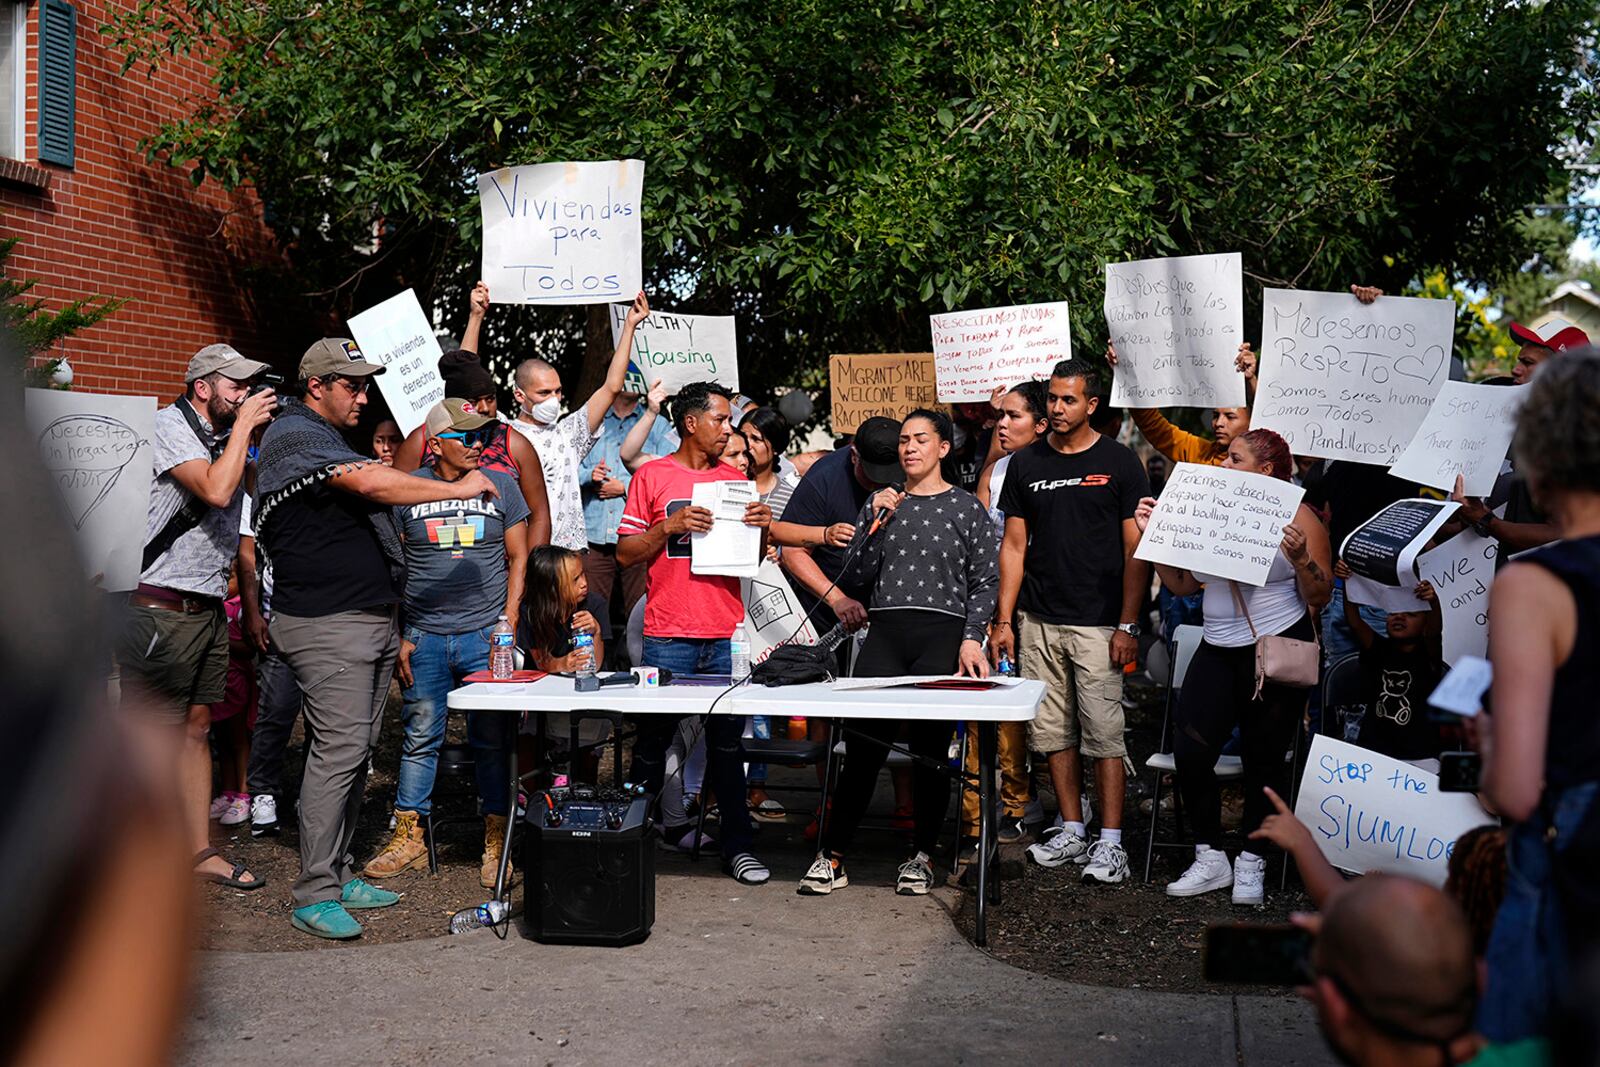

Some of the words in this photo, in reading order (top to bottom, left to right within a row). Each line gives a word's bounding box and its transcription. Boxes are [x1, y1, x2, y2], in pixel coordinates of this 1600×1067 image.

[491, 174, 633, 221] Viviendas
[548, 225, 601, 256] para
[503, 265, 621, 292] Todos
[613, 304, 695, 347] HALTHY
[1273, 303, 1416, 347] Meresemos
[378, 352, 394, 366] La
[391, 334, 427, 359] vivienda
[633, 335, 718, 374] Housing
[399, 363, 411, 377] es
[410, 355, 424, 370] un
[904, 359, 932, 383] ARE
[402, 370, 436, 396] derecho
[836, 386, 898, 403] WELCOME
[904, 385, 933, 403] HERE
[1268, 380, 1327, 399] Somos
[409, 386, 444, 412] humano
[1261, 402, 1309, 418] Como
[50, 424, 132, 441] Necesito
[68, 441, 107, 463] hogar
[1080, 474, 1111, 487] S
[410, 499, 500, 519] VENEZUELA
[1160, 502, 1174, 513] no
[1176, 505, 1187, 516] al
[1251, 520, 1261, 530] a
[1269, 522, 1280, 536] la
[1431, 557, 1476, 589] We
[1386, 768, 1428, 795] the
